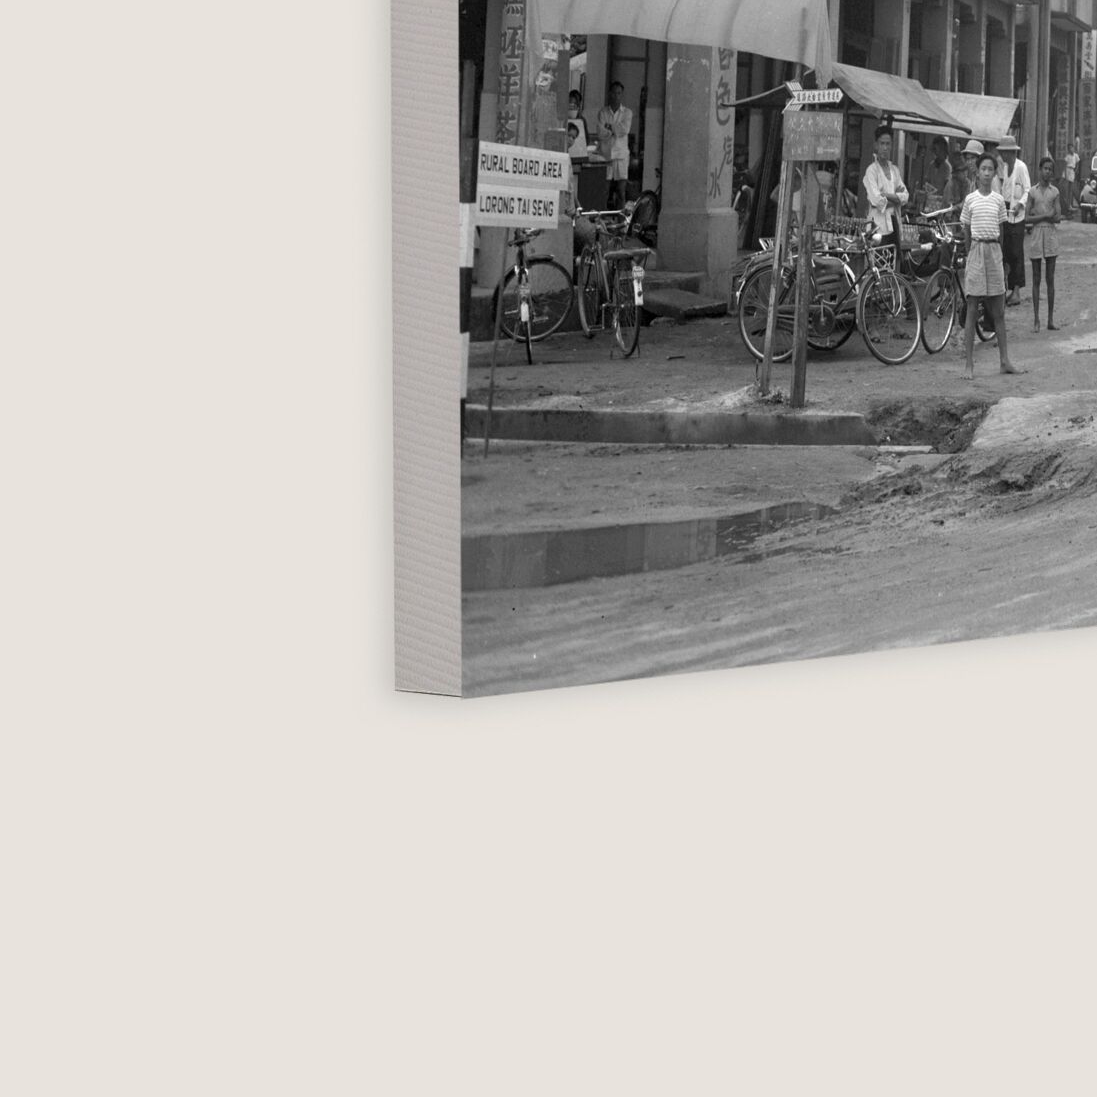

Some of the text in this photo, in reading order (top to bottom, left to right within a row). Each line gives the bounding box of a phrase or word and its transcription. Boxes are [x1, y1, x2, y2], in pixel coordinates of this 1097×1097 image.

[480, 153, 562, 178] RURAL BOARD AREA
[479, 195, 554, 217] LORONG TAI SENG
